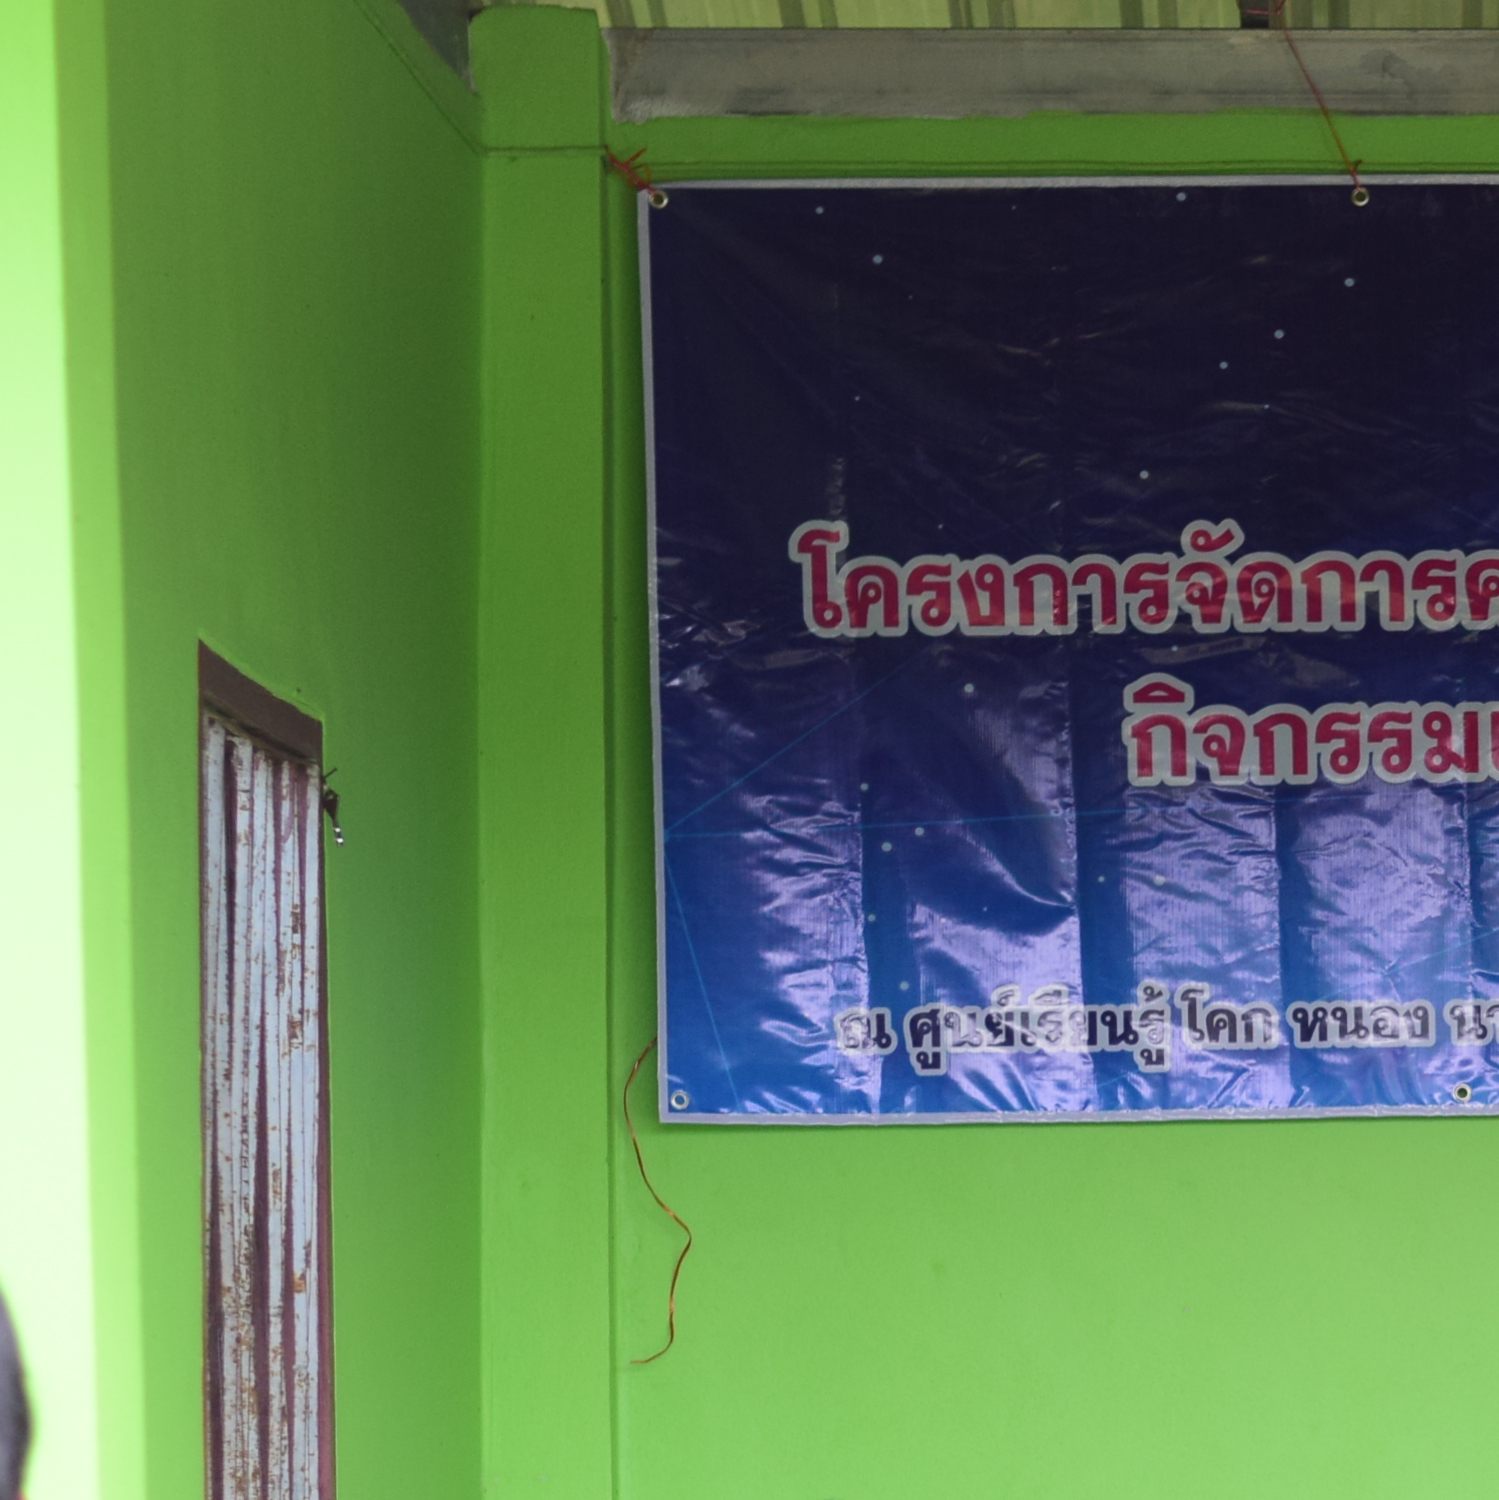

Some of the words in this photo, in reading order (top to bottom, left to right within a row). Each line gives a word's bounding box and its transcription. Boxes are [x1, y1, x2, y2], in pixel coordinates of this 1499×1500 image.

[836, 1008, 893, 1049] ณ
[905, 981, 1173, 1074] ศูนย์เรียนรู้
[1180, 987, 1278, 1046] โคก
[1289, 1000, 1434, 1048] หนอง
